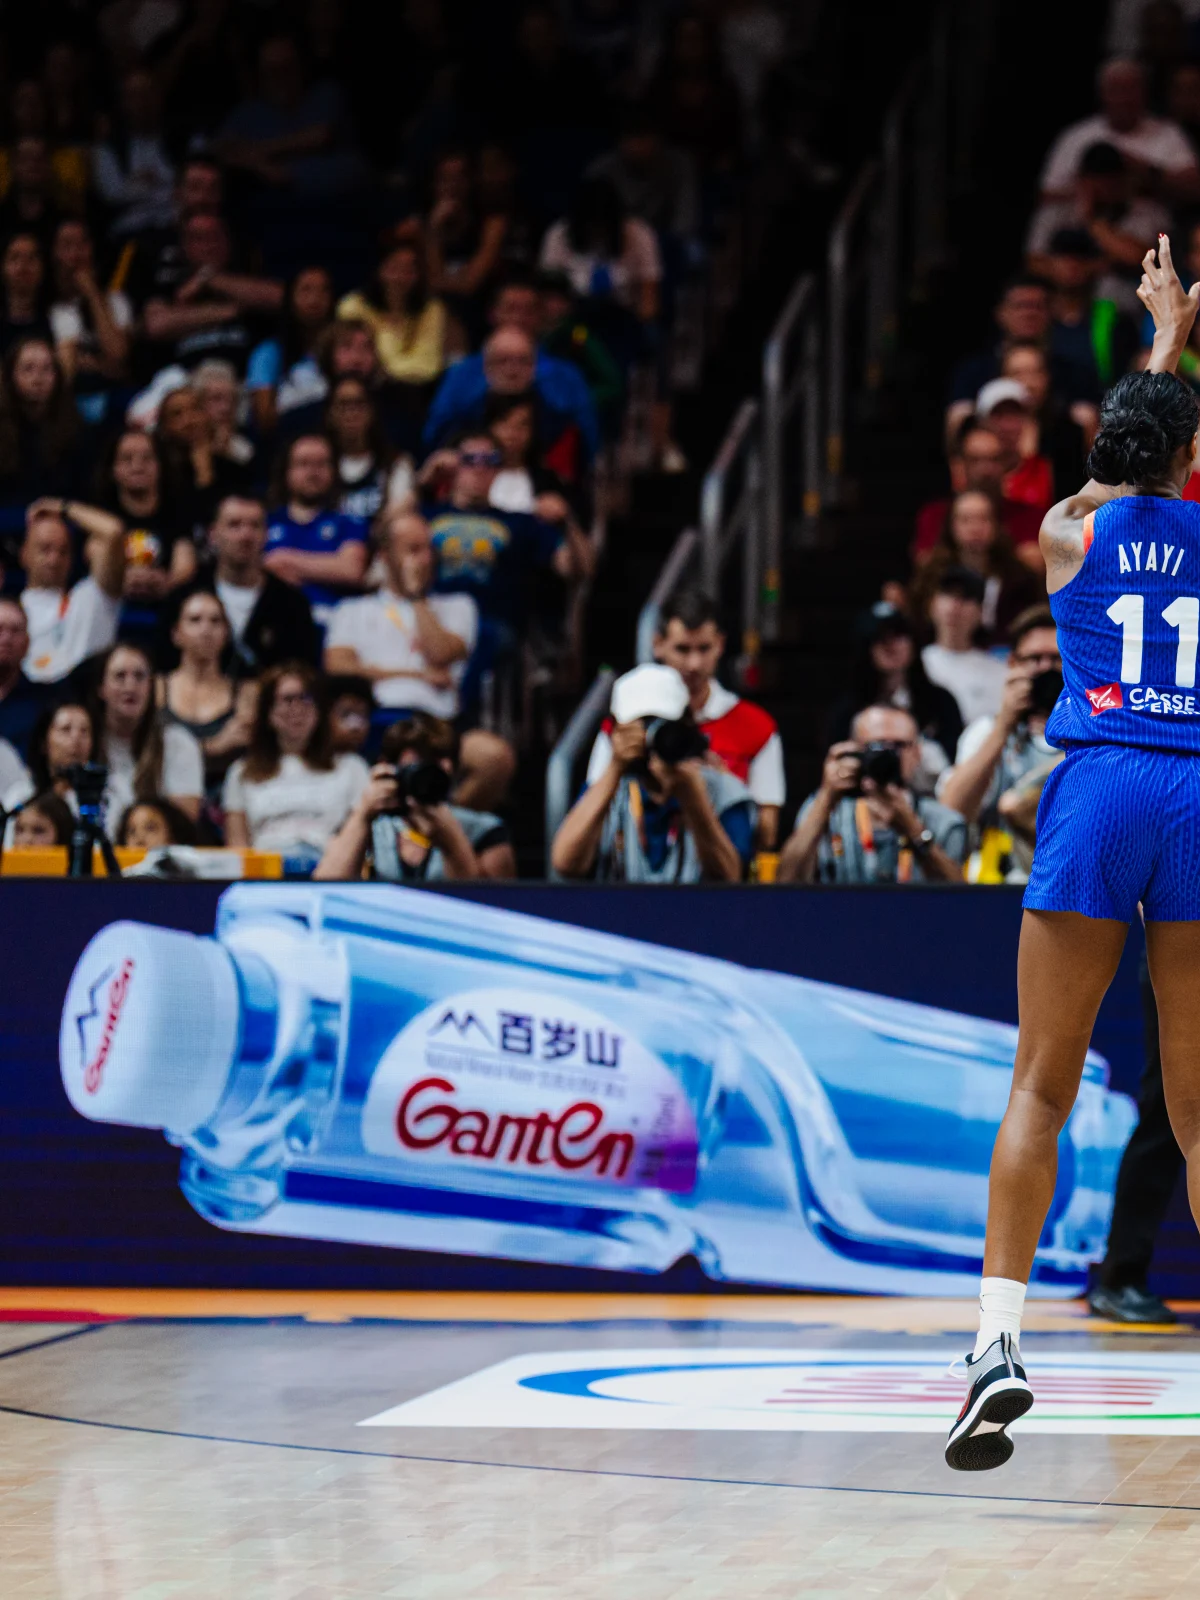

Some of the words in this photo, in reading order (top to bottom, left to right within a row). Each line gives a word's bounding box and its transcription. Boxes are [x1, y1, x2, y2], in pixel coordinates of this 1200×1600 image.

[1118, 541, 1185, 577] AYAYI
[1106, 594, 1199, 688] 11
[497, 1010, 623, 1069] 百岁山
[396, 1077, 635, 1178] Ganten
